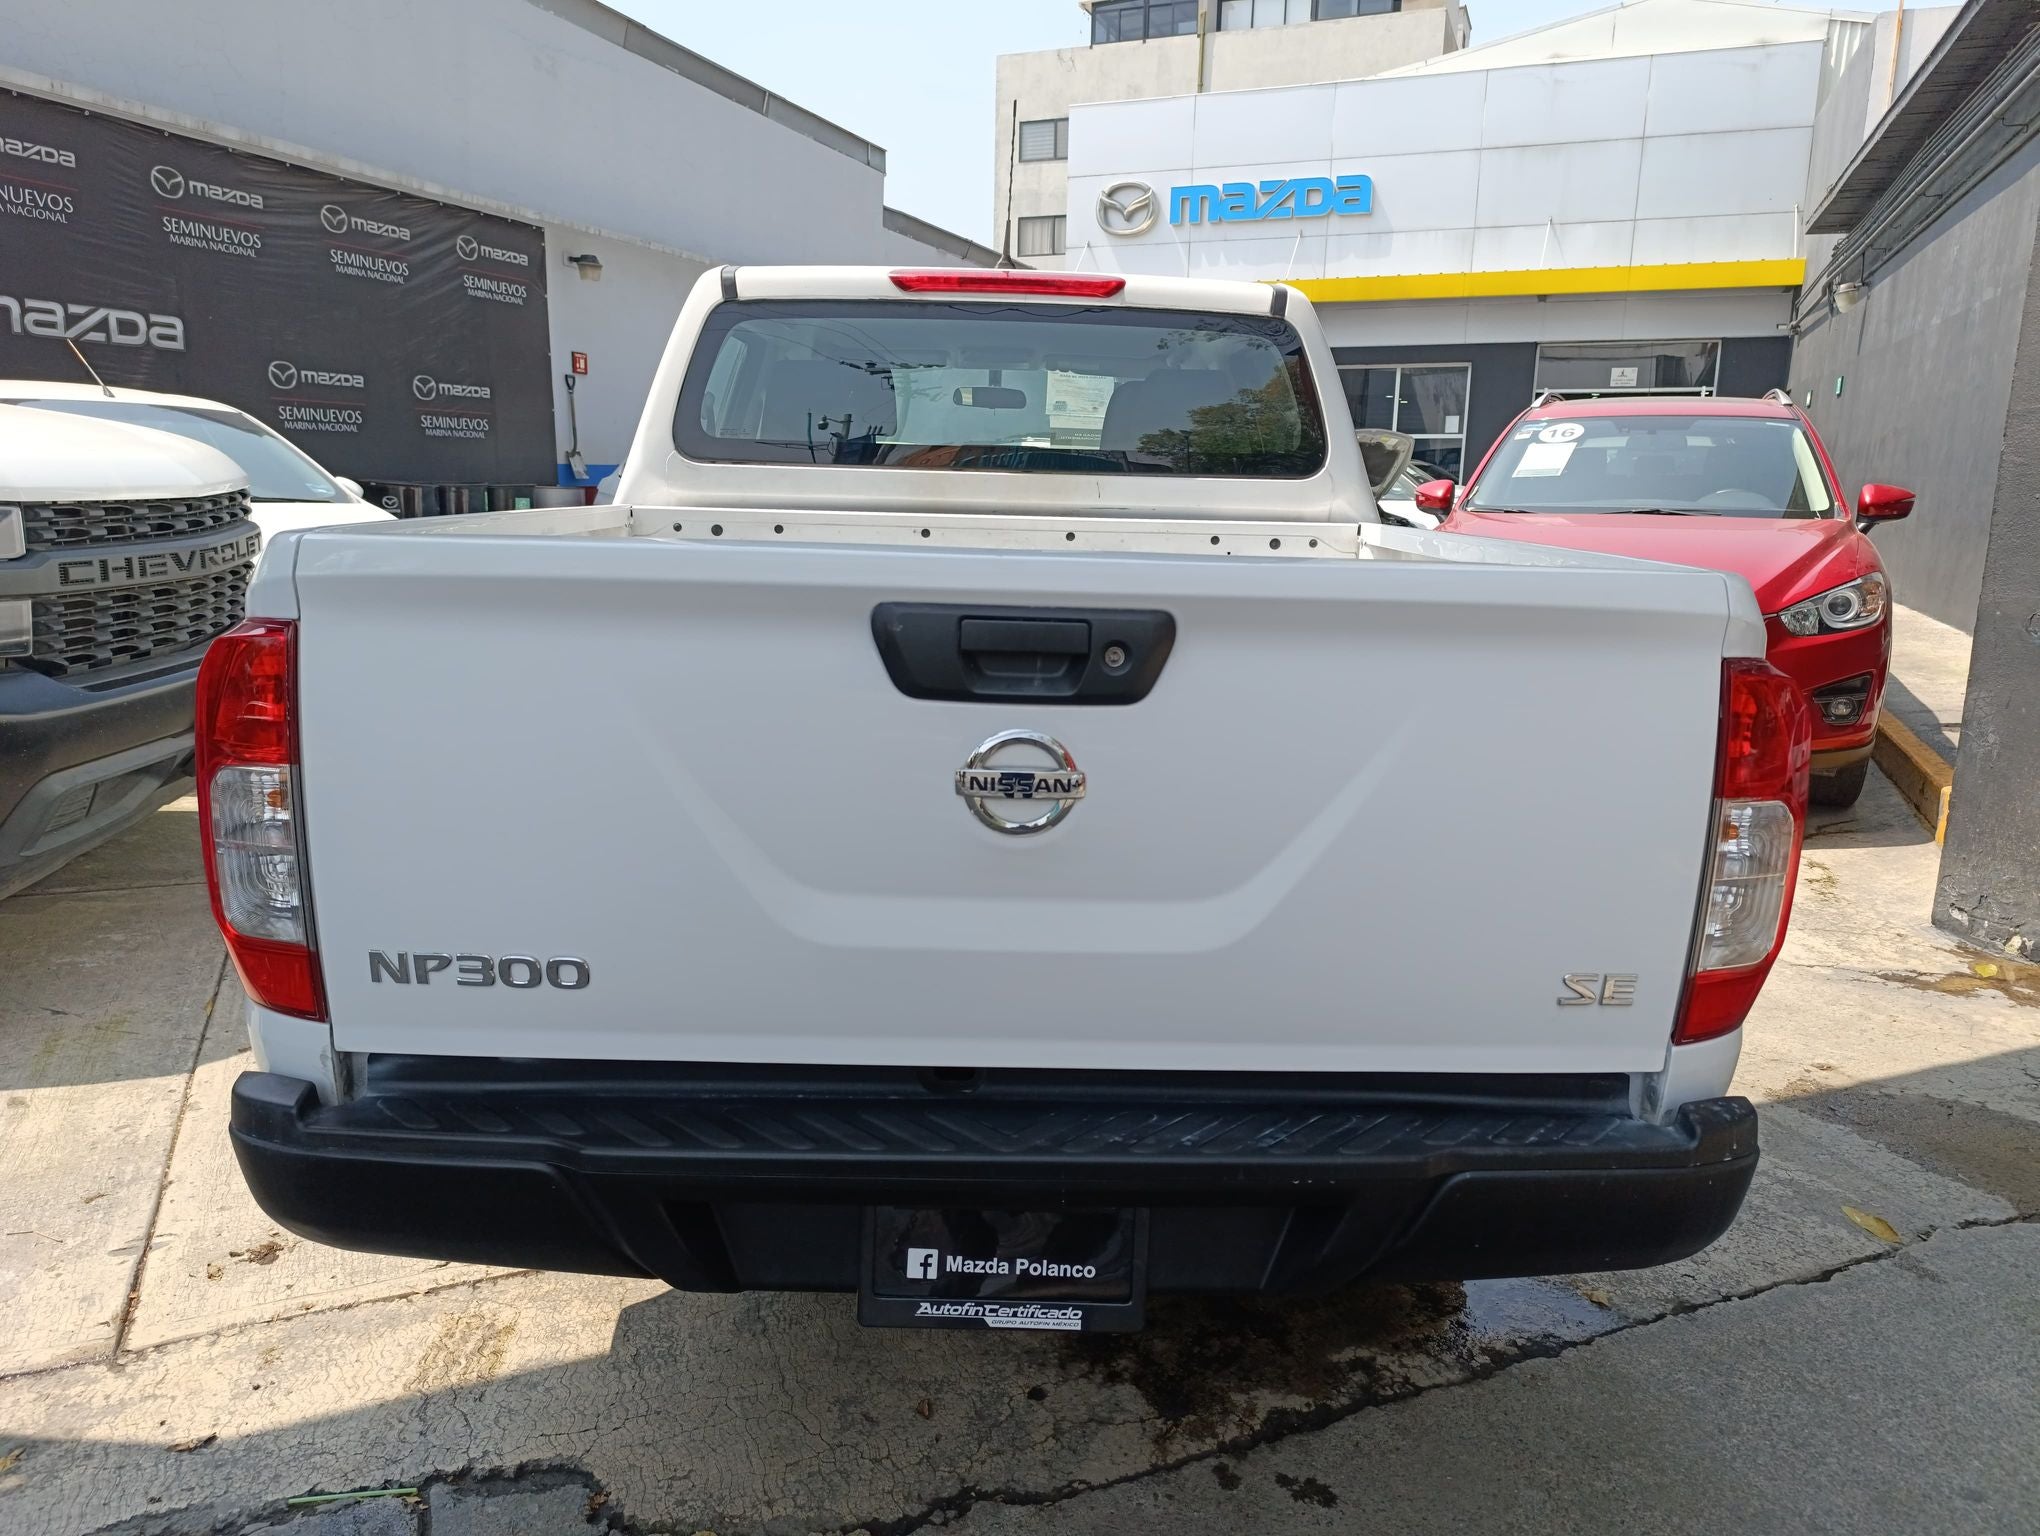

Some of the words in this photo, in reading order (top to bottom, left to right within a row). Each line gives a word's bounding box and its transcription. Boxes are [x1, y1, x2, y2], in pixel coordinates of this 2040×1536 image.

[0, 137, 76, 168] azda
[7, 203, 68, 224] NACIONAL
[162, 216, 262, 249] SEMINUEVOS
[169, 233, 209, 249] MARINA
[209, 240, 257, 258] NACIONAL
[330, 249, 409, 276] SEMINUEVOS
[335, 264, 367, 278] MARINA
[367, 270, 405, 285] NACIONAL
[463, 274, 527, 298] SEMINUEVOS
[278, 406, 363, 424] SEMINUEVOS
[284, 421, 318, 431] MARINA
[318, 423, 359, 433] NACIONAL
[420, 415, 489, 431] SEMINUEVOS
[1548, 428, 1576, 439] 16
[968, 775, 1072, 793] NISSAN
[368, 949, 591, 989] NP300
[1557, 972, 1639, 1006] SE
[946, 1255, 1009, 1275] Mazda
[1015, 1258, 1097, 1279] Polanco
